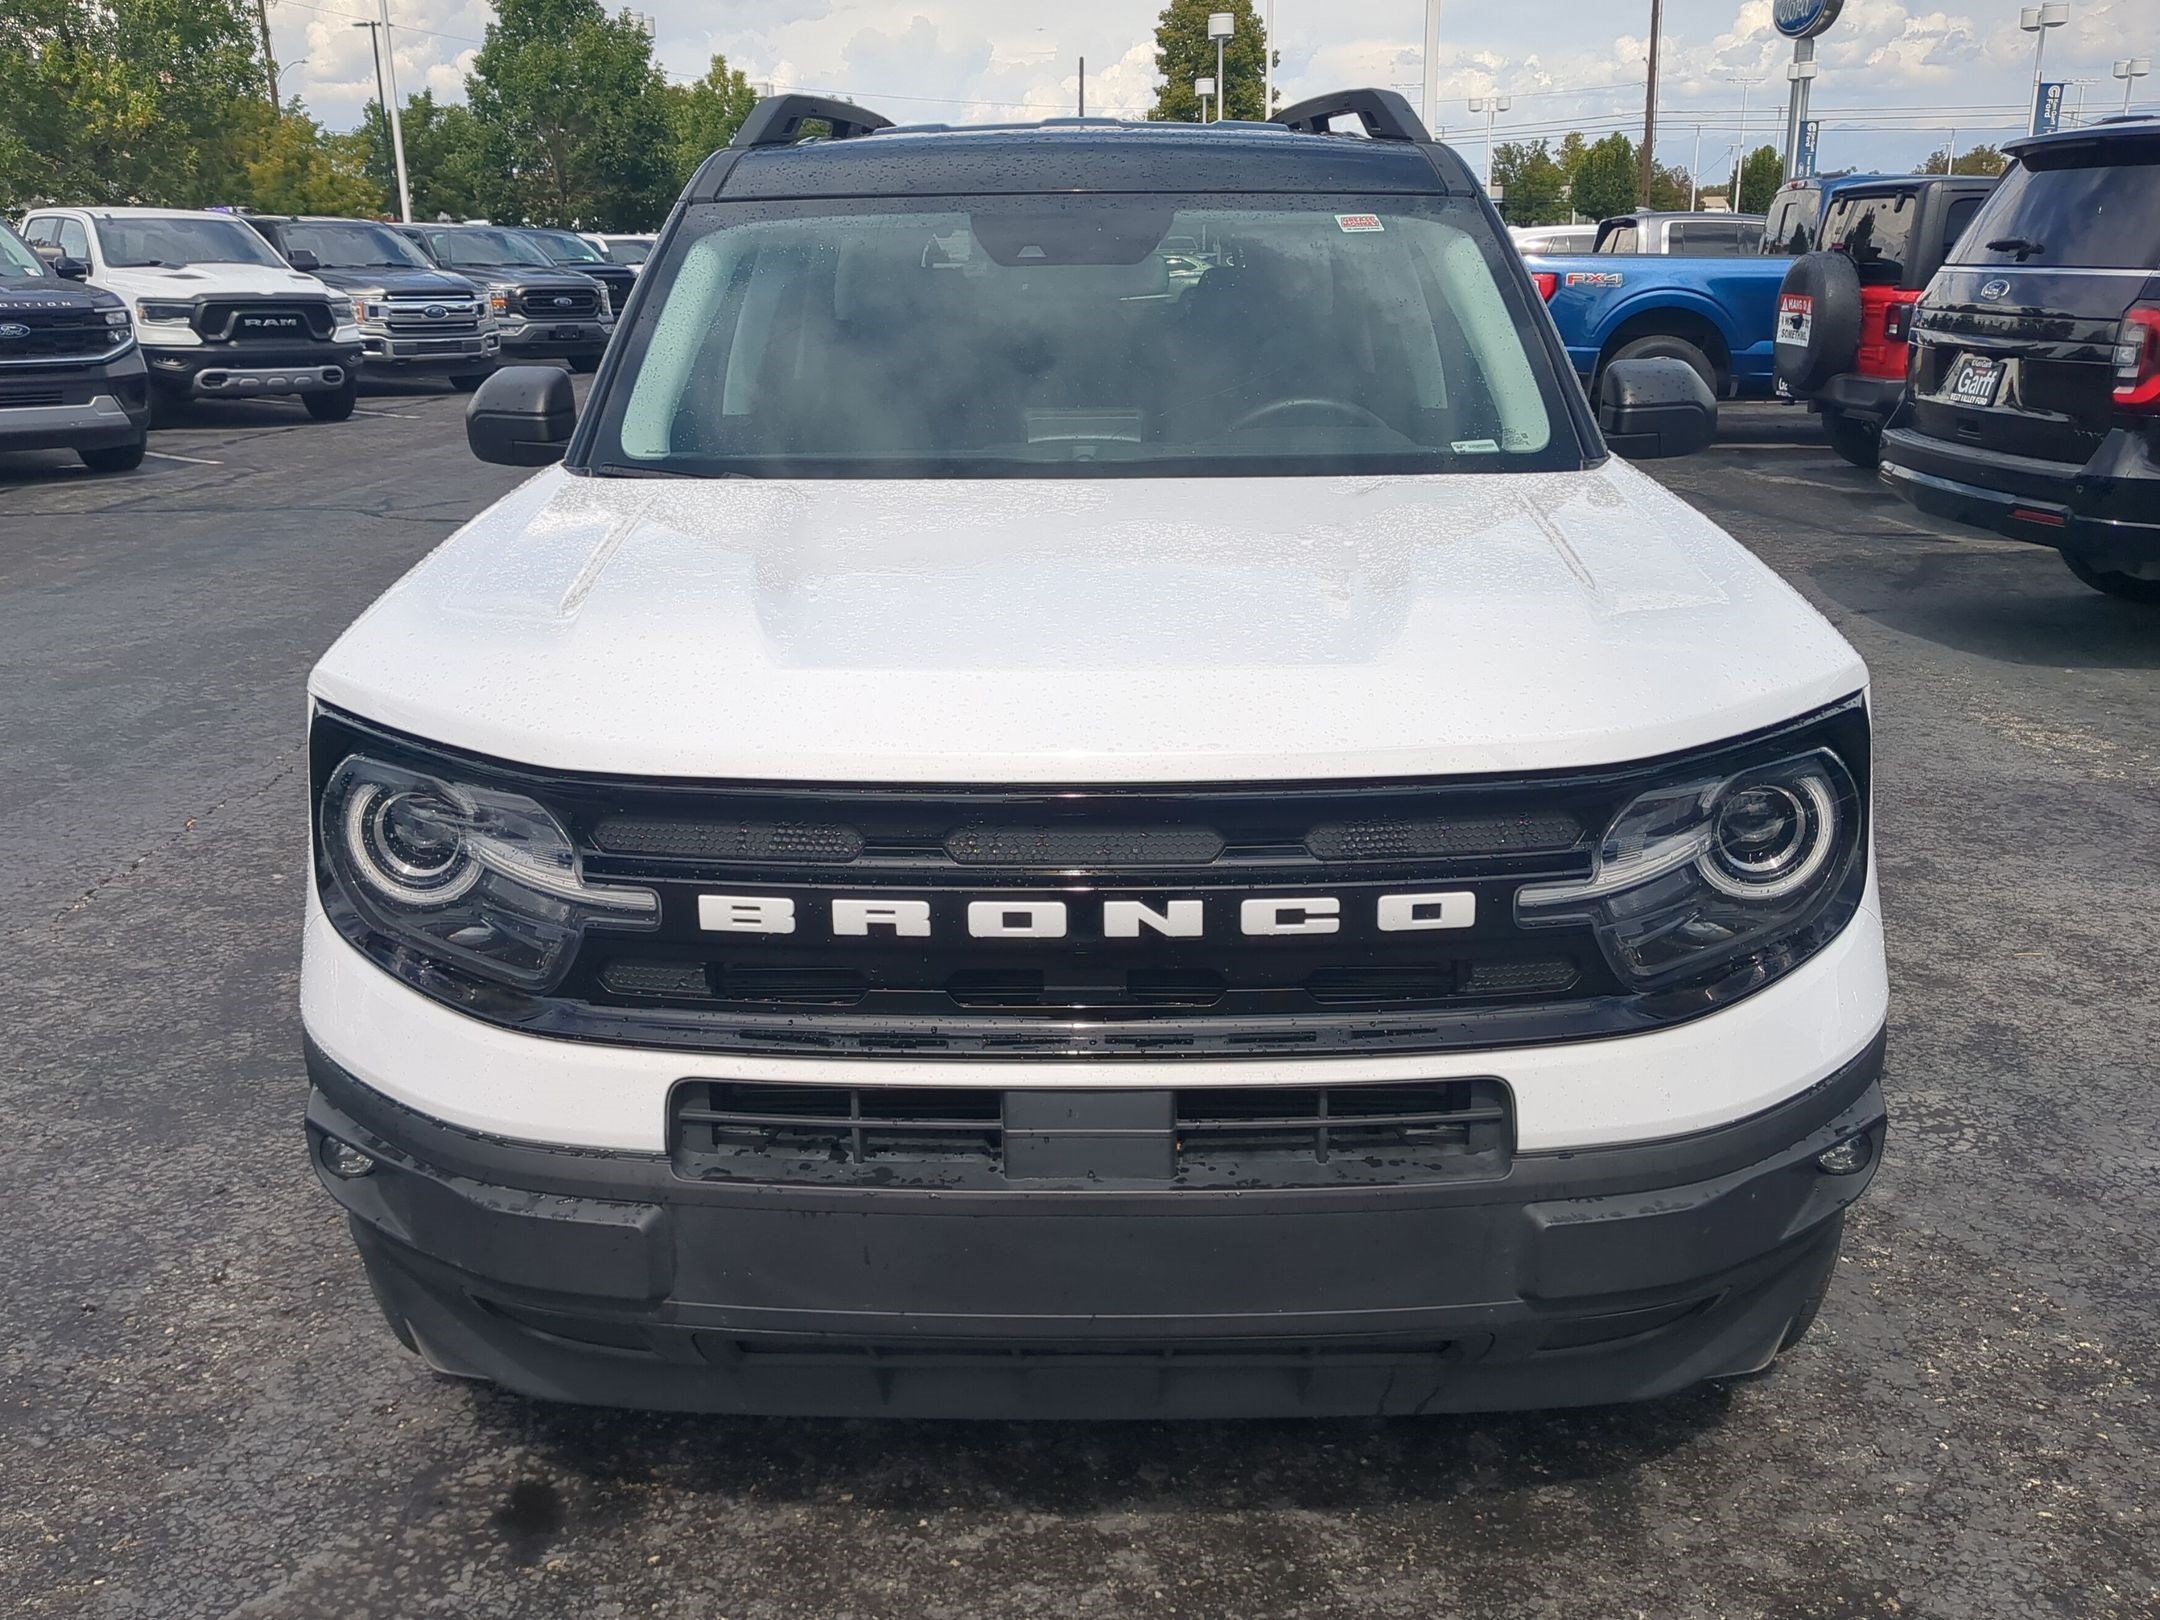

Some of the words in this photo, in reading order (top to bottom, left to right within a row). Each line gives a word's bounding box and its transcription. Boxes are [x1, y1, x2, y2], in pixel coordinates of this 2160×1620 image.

[1564, 272, 1622, 288] FX4
[244, 318, 297, 327] RAM
[1957, 367, 1998, 396] Garff
[698, 891, 1476, 937] BRONCO
